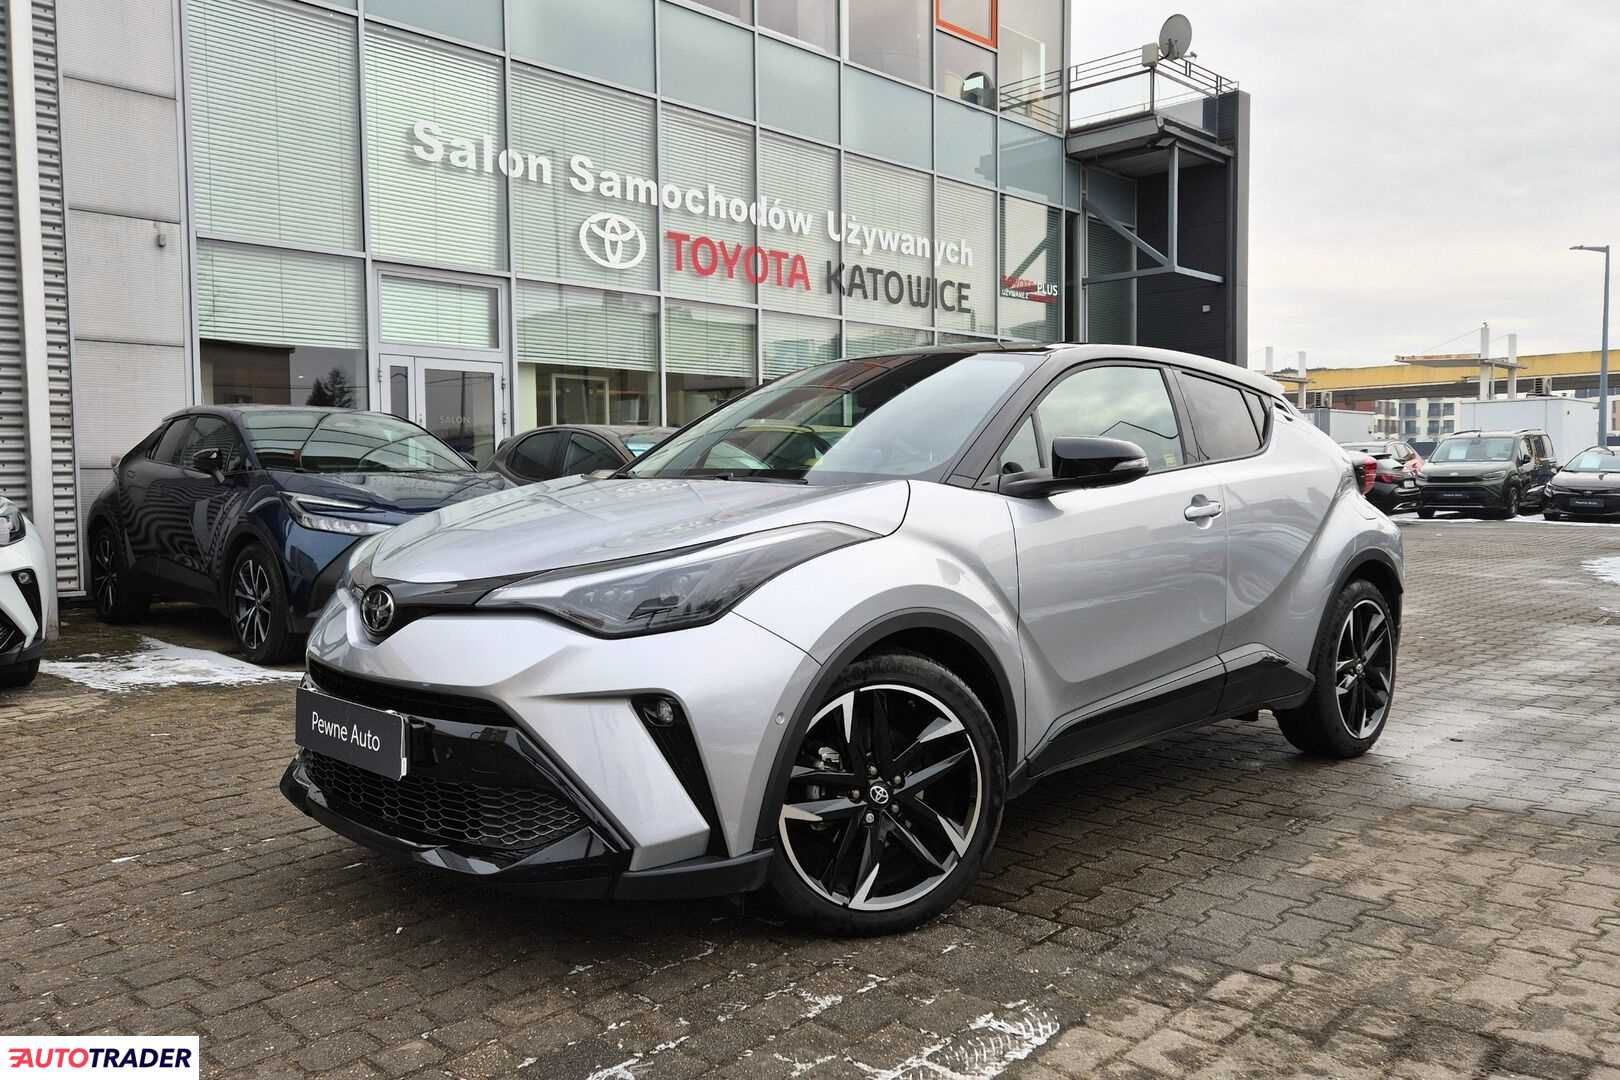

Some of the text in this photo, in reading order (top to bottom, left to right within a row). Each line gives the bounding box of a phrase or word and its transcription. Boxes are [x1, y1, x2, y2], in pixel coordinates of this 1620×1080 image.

[413, 120, 973, 266] Salon Samochodów Używanych
[667, 231, 972, 314] TOYOTA KATOWICE
[1037, 281, 1058, 296] PLUS
[439, 415, 472, 424] SALON
[312, 711, 381, 751] Pewne Auto
